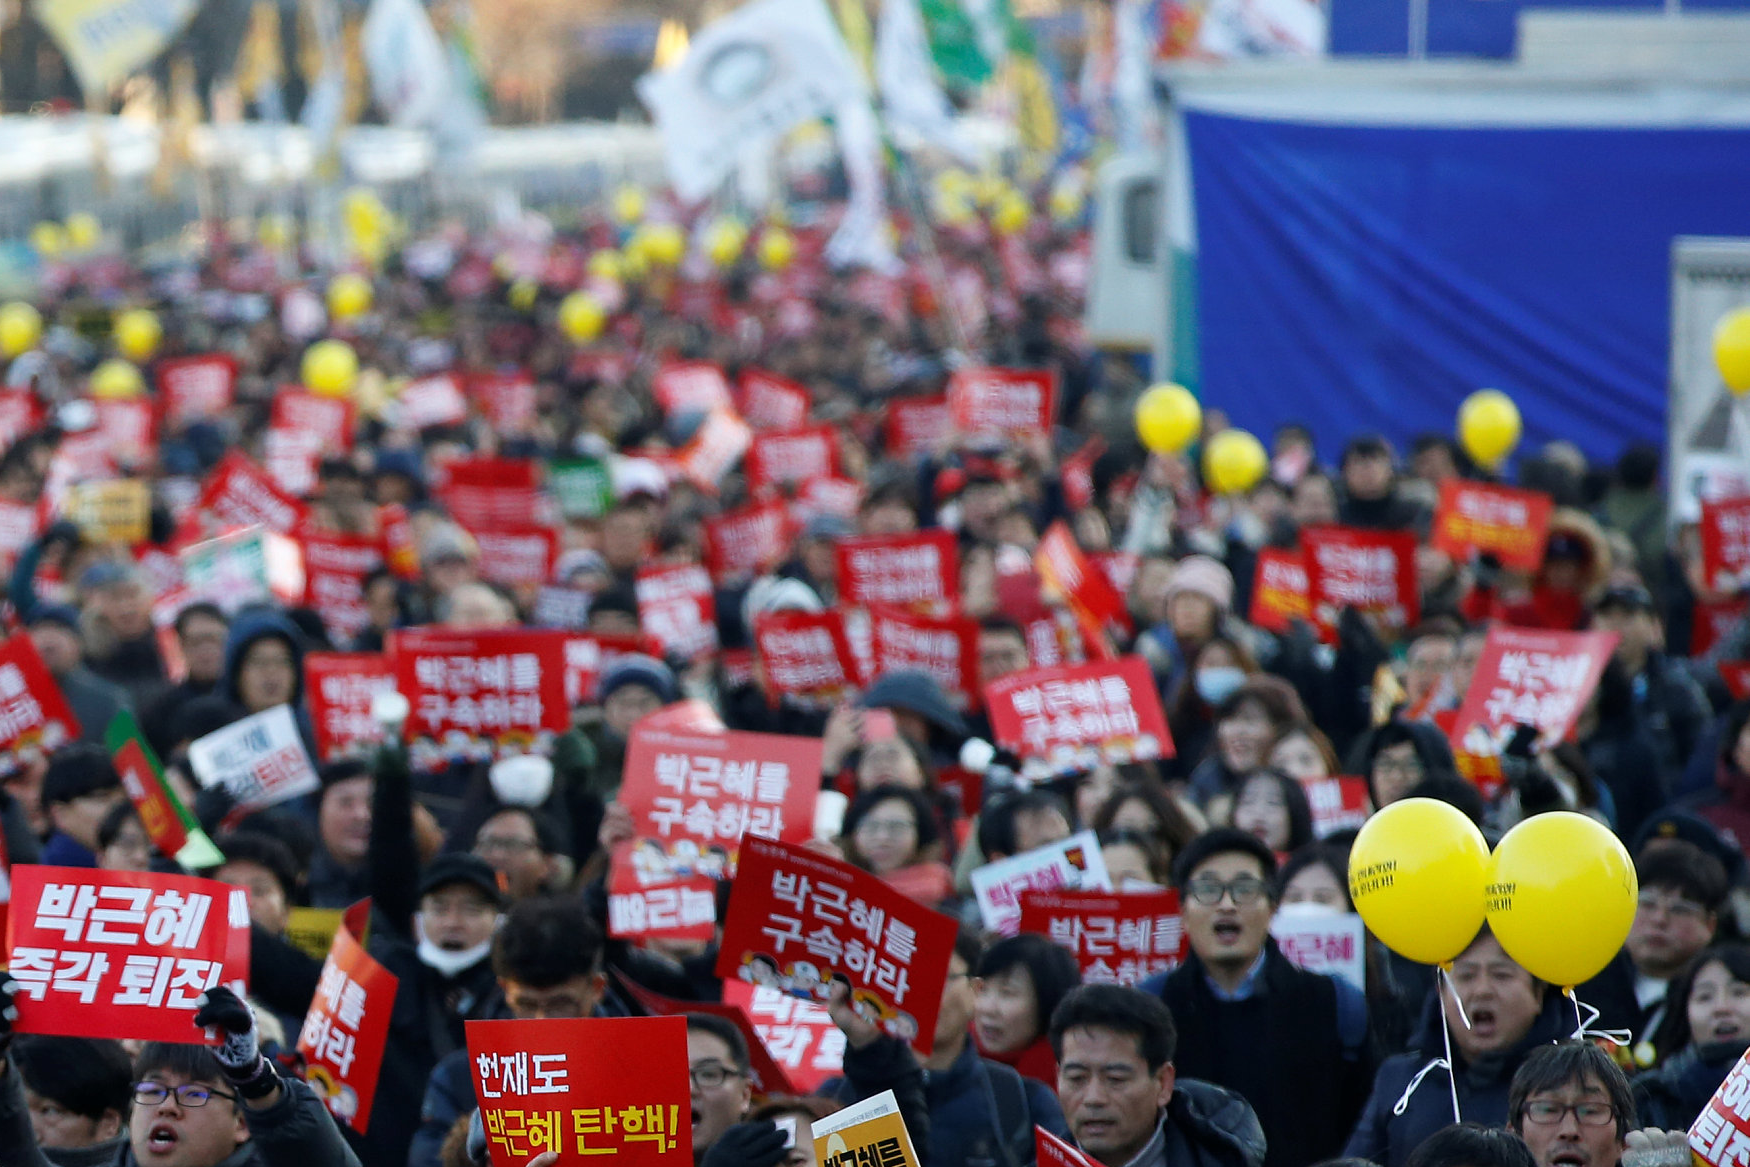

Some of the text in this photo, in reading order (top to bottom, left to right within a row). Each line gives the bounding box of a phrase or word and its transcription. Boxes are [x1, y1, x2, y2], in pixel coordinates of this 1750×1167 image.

[655, 752, 790, 802] 박근혜를
[649, 795, 786, 842] 구속하라
[34, 882, 213, 951] 박근혜
[773, 868, 918, 965] 박근혜를
[1049, 911, 1184, 957] 박근혜를
[7, 945, 224, 1011] 즉각 퇴진
[762, 912, 911, 1006] 구속하라
[476, 1051, 570, 1099] 헌재도
[488, 1103, 679, 1157] 박근혜 탄핵!
